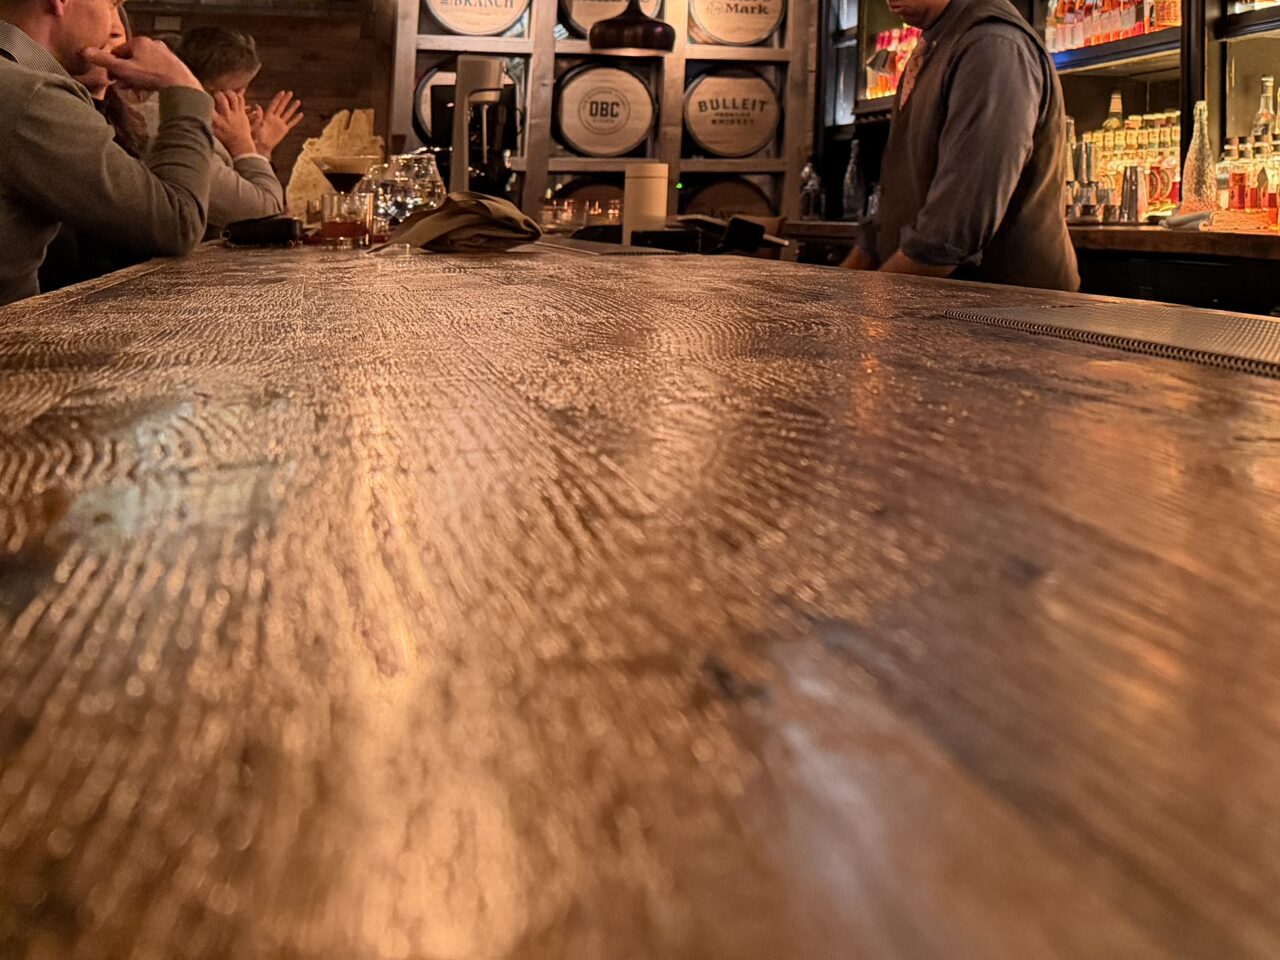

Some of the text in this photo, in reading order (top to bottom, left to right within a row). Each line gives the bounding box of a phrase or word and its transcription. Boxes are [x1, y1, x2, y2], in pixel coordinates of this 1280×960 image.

[725, 3, 770, 15] Mark
[589, 100, 620, 118] OBC
[697, 97, 769, 113] BULLEIT
